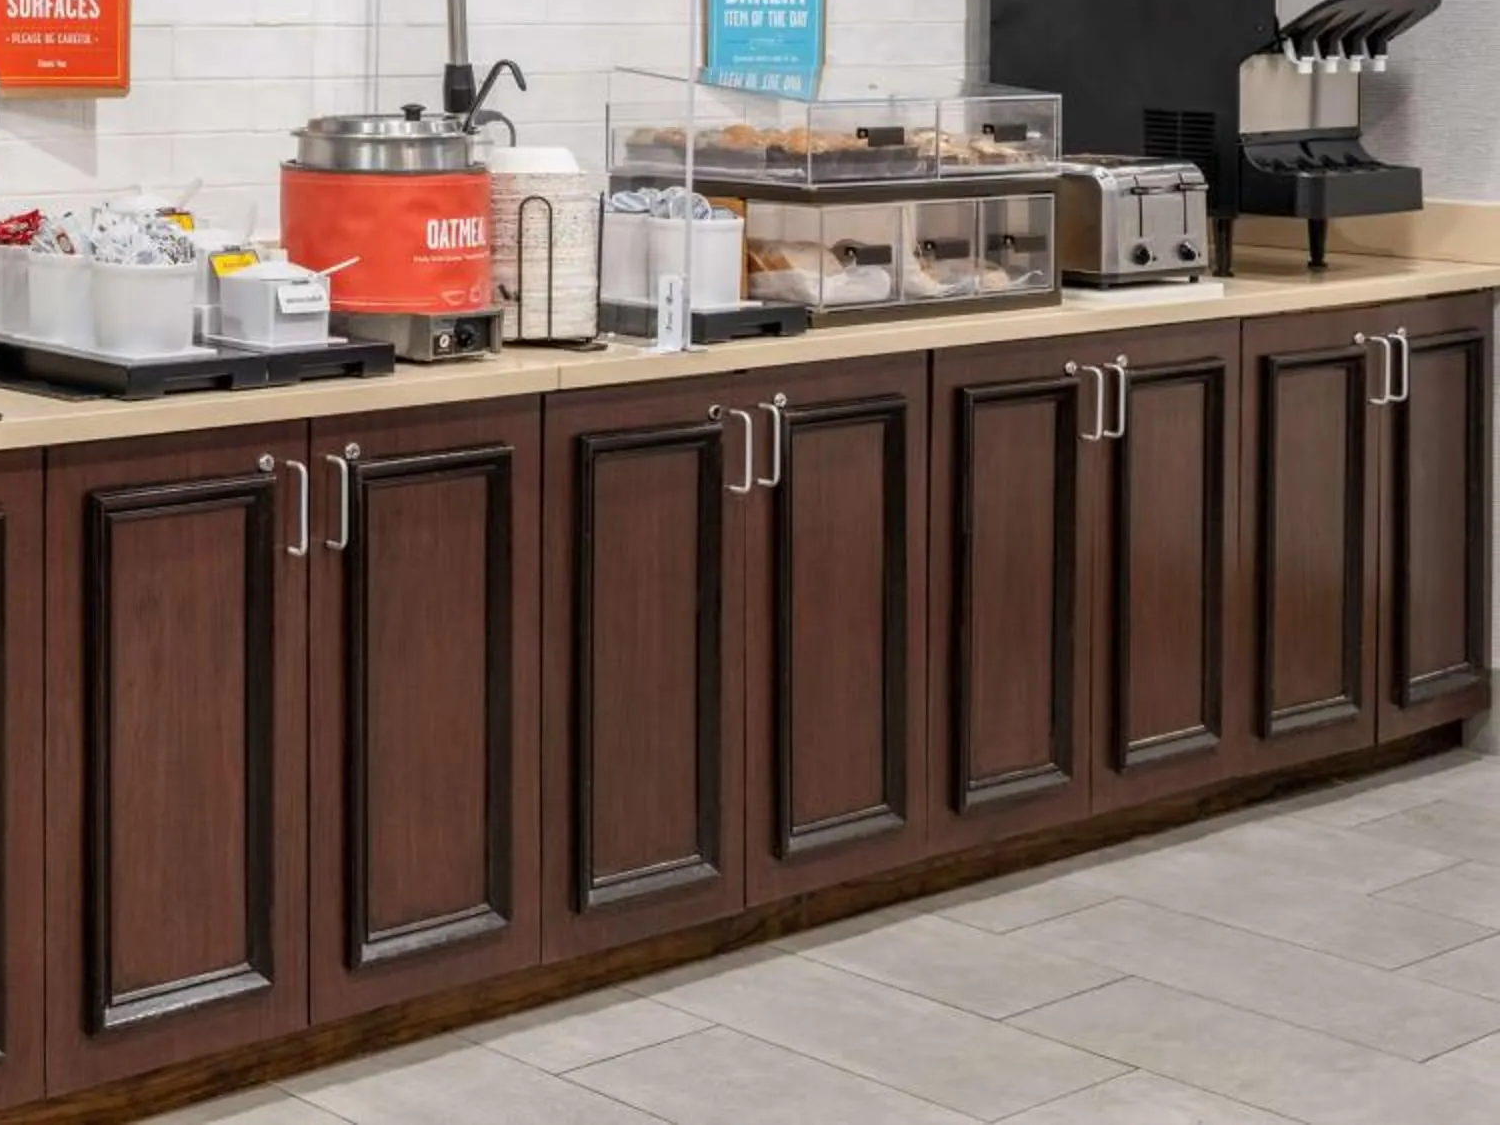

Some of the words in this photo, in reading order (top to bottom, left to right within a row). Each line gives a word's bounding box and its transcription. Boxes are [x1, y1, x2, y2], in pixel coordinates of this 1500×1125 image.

[724, 10, 748, 27] ITEM
[768, 10, 785, 27] THE
[790, 10, 808, 27] DAY
